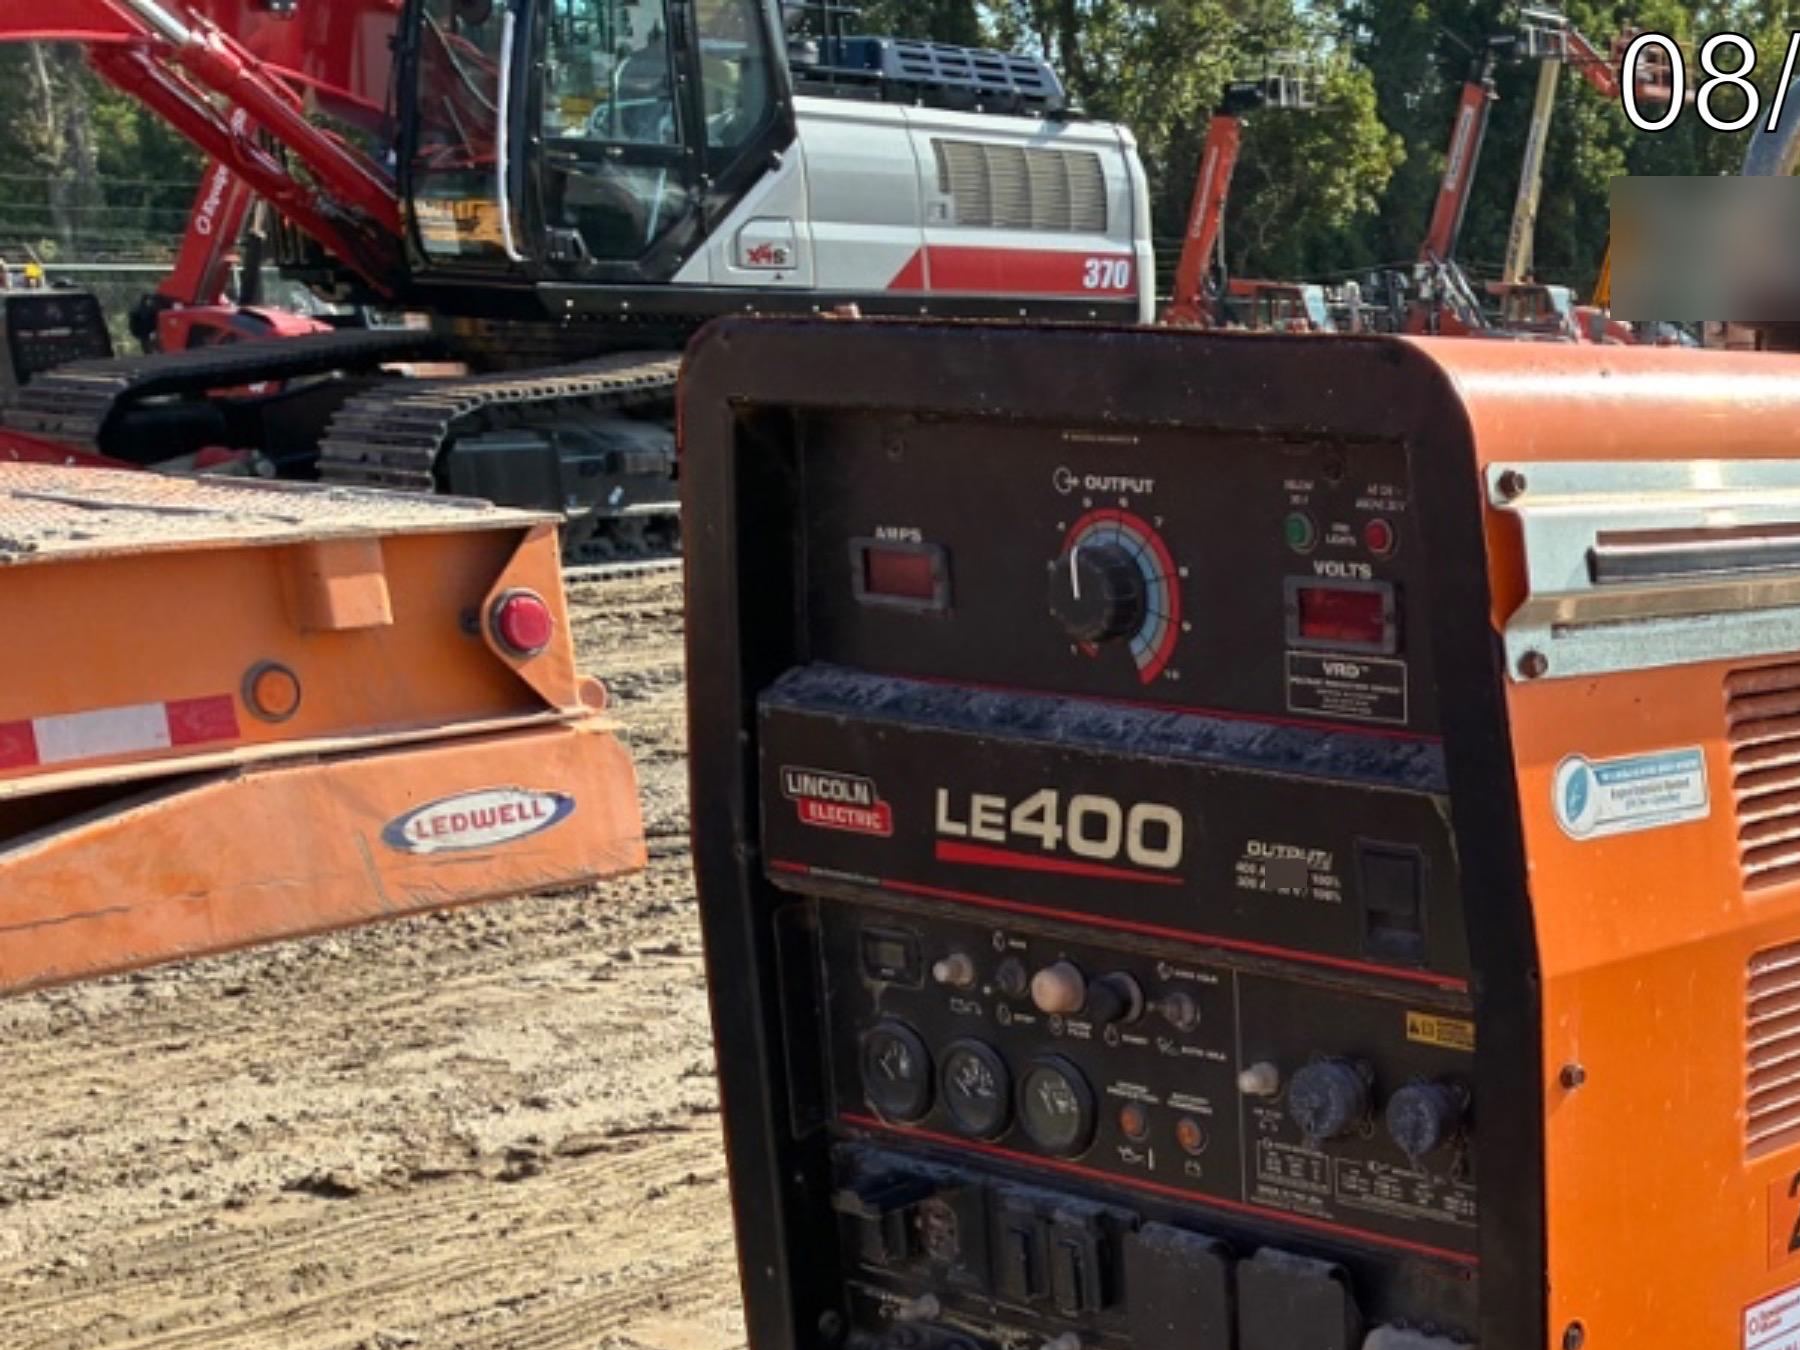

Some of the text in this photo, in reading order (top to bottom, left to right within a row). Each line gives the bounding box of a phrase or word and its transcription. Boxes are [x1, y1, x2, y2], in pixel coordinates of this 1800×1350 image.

[1083, 258, 1130, 290] 370
[1085, 474, 1156, 494] OUTPUT
[1314, 560, 1372, 579] VOLTS
[786, 771, 869, 805] LINCOLN
[414, 799, 547, 840] LEDWELL
[809, 803, 881, 830] ELECTRIC
[935, 787, 1184, 869] LE400
